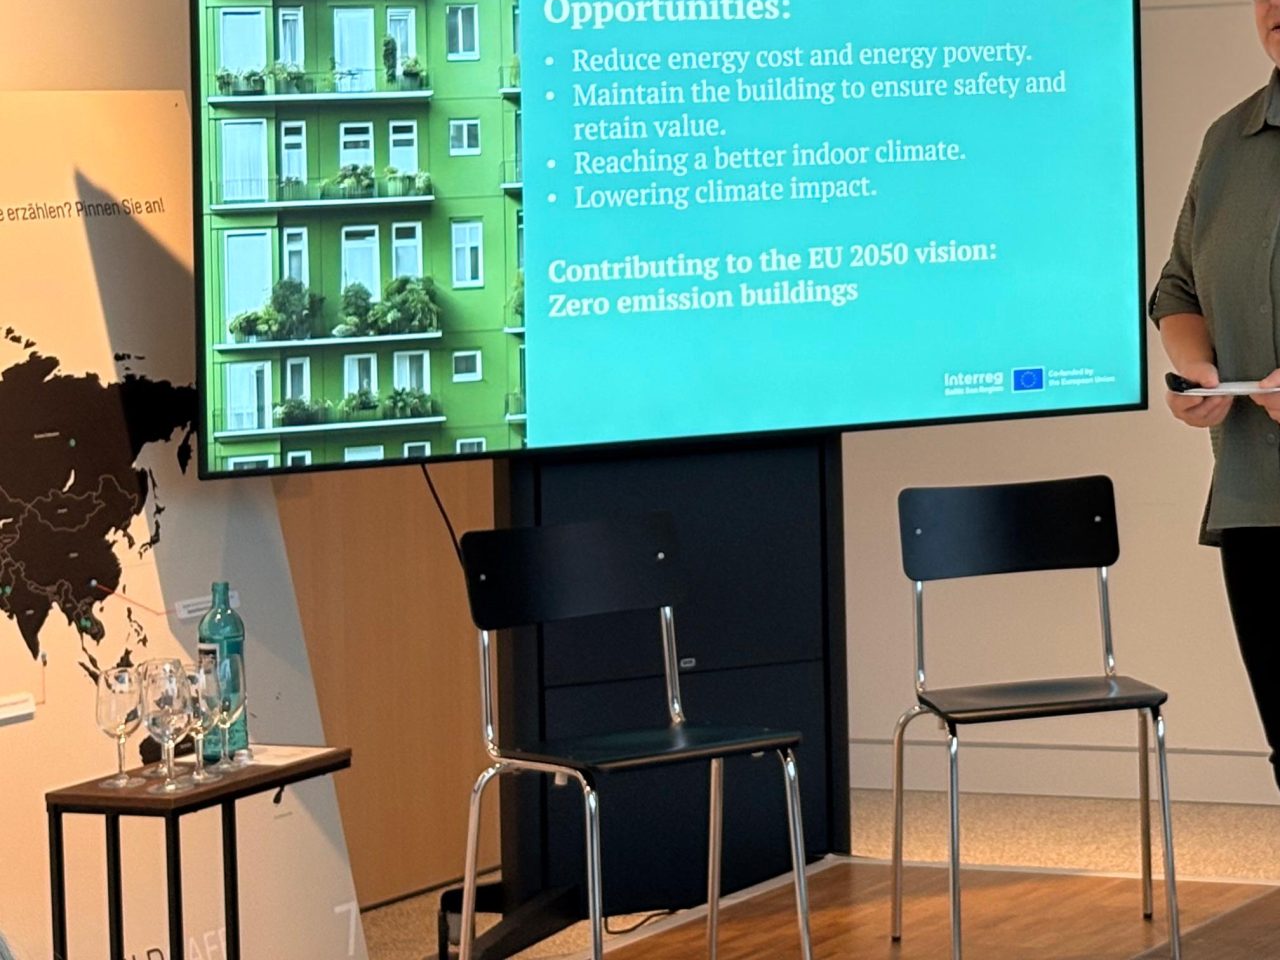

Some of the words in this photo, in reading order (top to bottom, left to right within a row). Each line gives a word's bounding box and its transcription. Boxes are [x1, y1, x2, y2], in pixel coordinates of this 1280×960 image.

[572, 47, 661, 72] Reduce
[668, 51, 750, 74] energy
[756, 47, 803, 68] cost
[810, 42, 853, 66] and
[859, 47, 937, 69] energy
[943, 43, 1032, 66] poverty.
[573, 81, 685, 106] Maintain
[691, 79, 730, 103] the
[736, 77, 836, 105] building
[841, 79, 865, 99] to
[871, 80, 948, 98] ensure
[954, 72, 1020, 96] safety
[1026, 70, 1066, 93] and
[574, 116, 648, 141] retain
[653, 114, 726, 137] value.
[574, 149, 689, 176] Reaching
[694, 153, 708, 170] a
[714, 145, 787, 169] better
[792, 141, 870, 166] indoor
[875, 139, 966, 163] climate.
[7, 201, 72, 222] erzählen?
[75, 200, 120, 218] Pinnen
[121, 198, 143, 216] Sie
[144, 197, 165, 214] an!
[575, 184, 690, 210] Lowering
[695, 179, 784, 203] climate
[790, 176, 877, 203] impact.
[548, 253, 720, 283] Contributing
[726, 254, 753, 274] to
[759, 248, 802, 272] the
[808, 246, 843, 269] EU
[850, 243, 909, 267] 2050
[914, 240, 997, 264] vision:
[549, 294, 610, 318] Zero
[616, 286, 734, 314] emission
[739, 280, 859, 307] buildings
[944, 372, 1003, 387] Interreg
